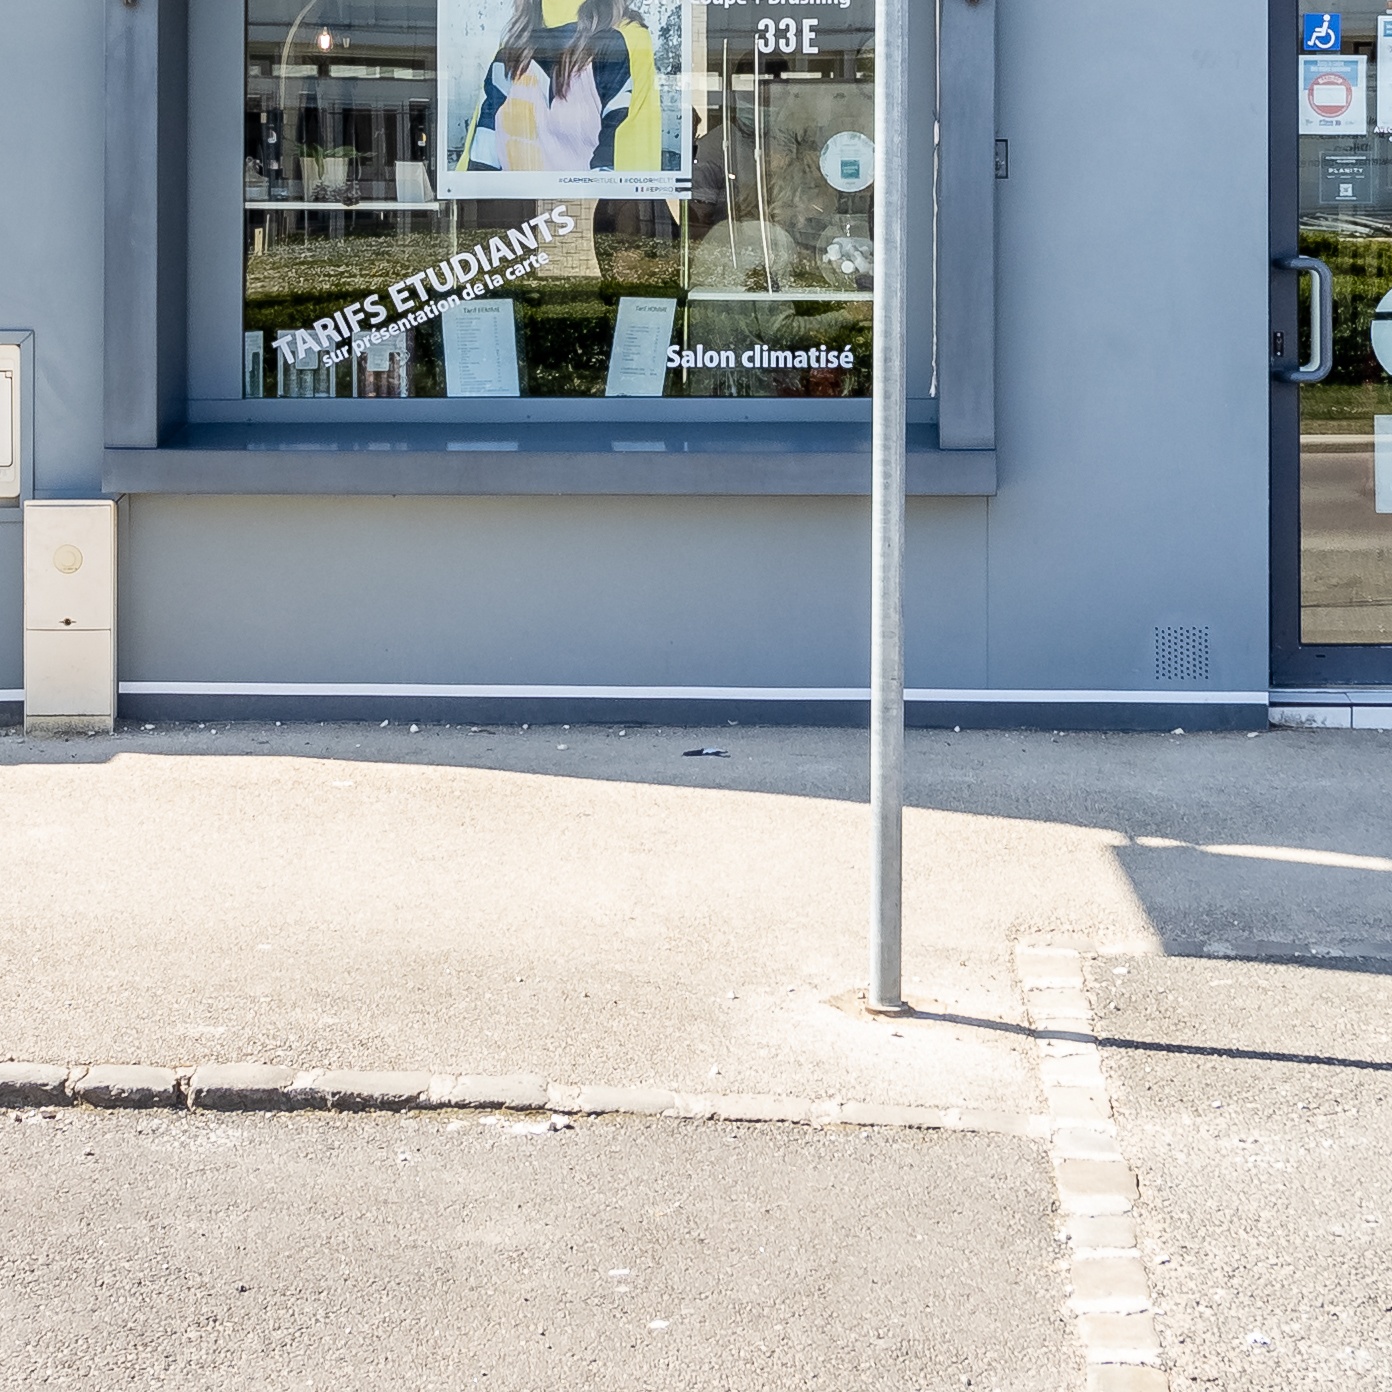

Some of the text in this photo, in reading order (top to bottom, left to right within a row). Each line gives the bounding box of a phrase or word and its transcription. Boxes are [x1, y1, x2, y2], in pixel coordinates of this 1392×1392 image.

[271, 294, 388, 366] TARIFS
[388, 204, 576, 313] ETUDIANTS
[322, 250, 550, 368] sur présentation de la carte
[666, 344, 735, 368] Salon
[741, 344, 854, 368] climatisé
